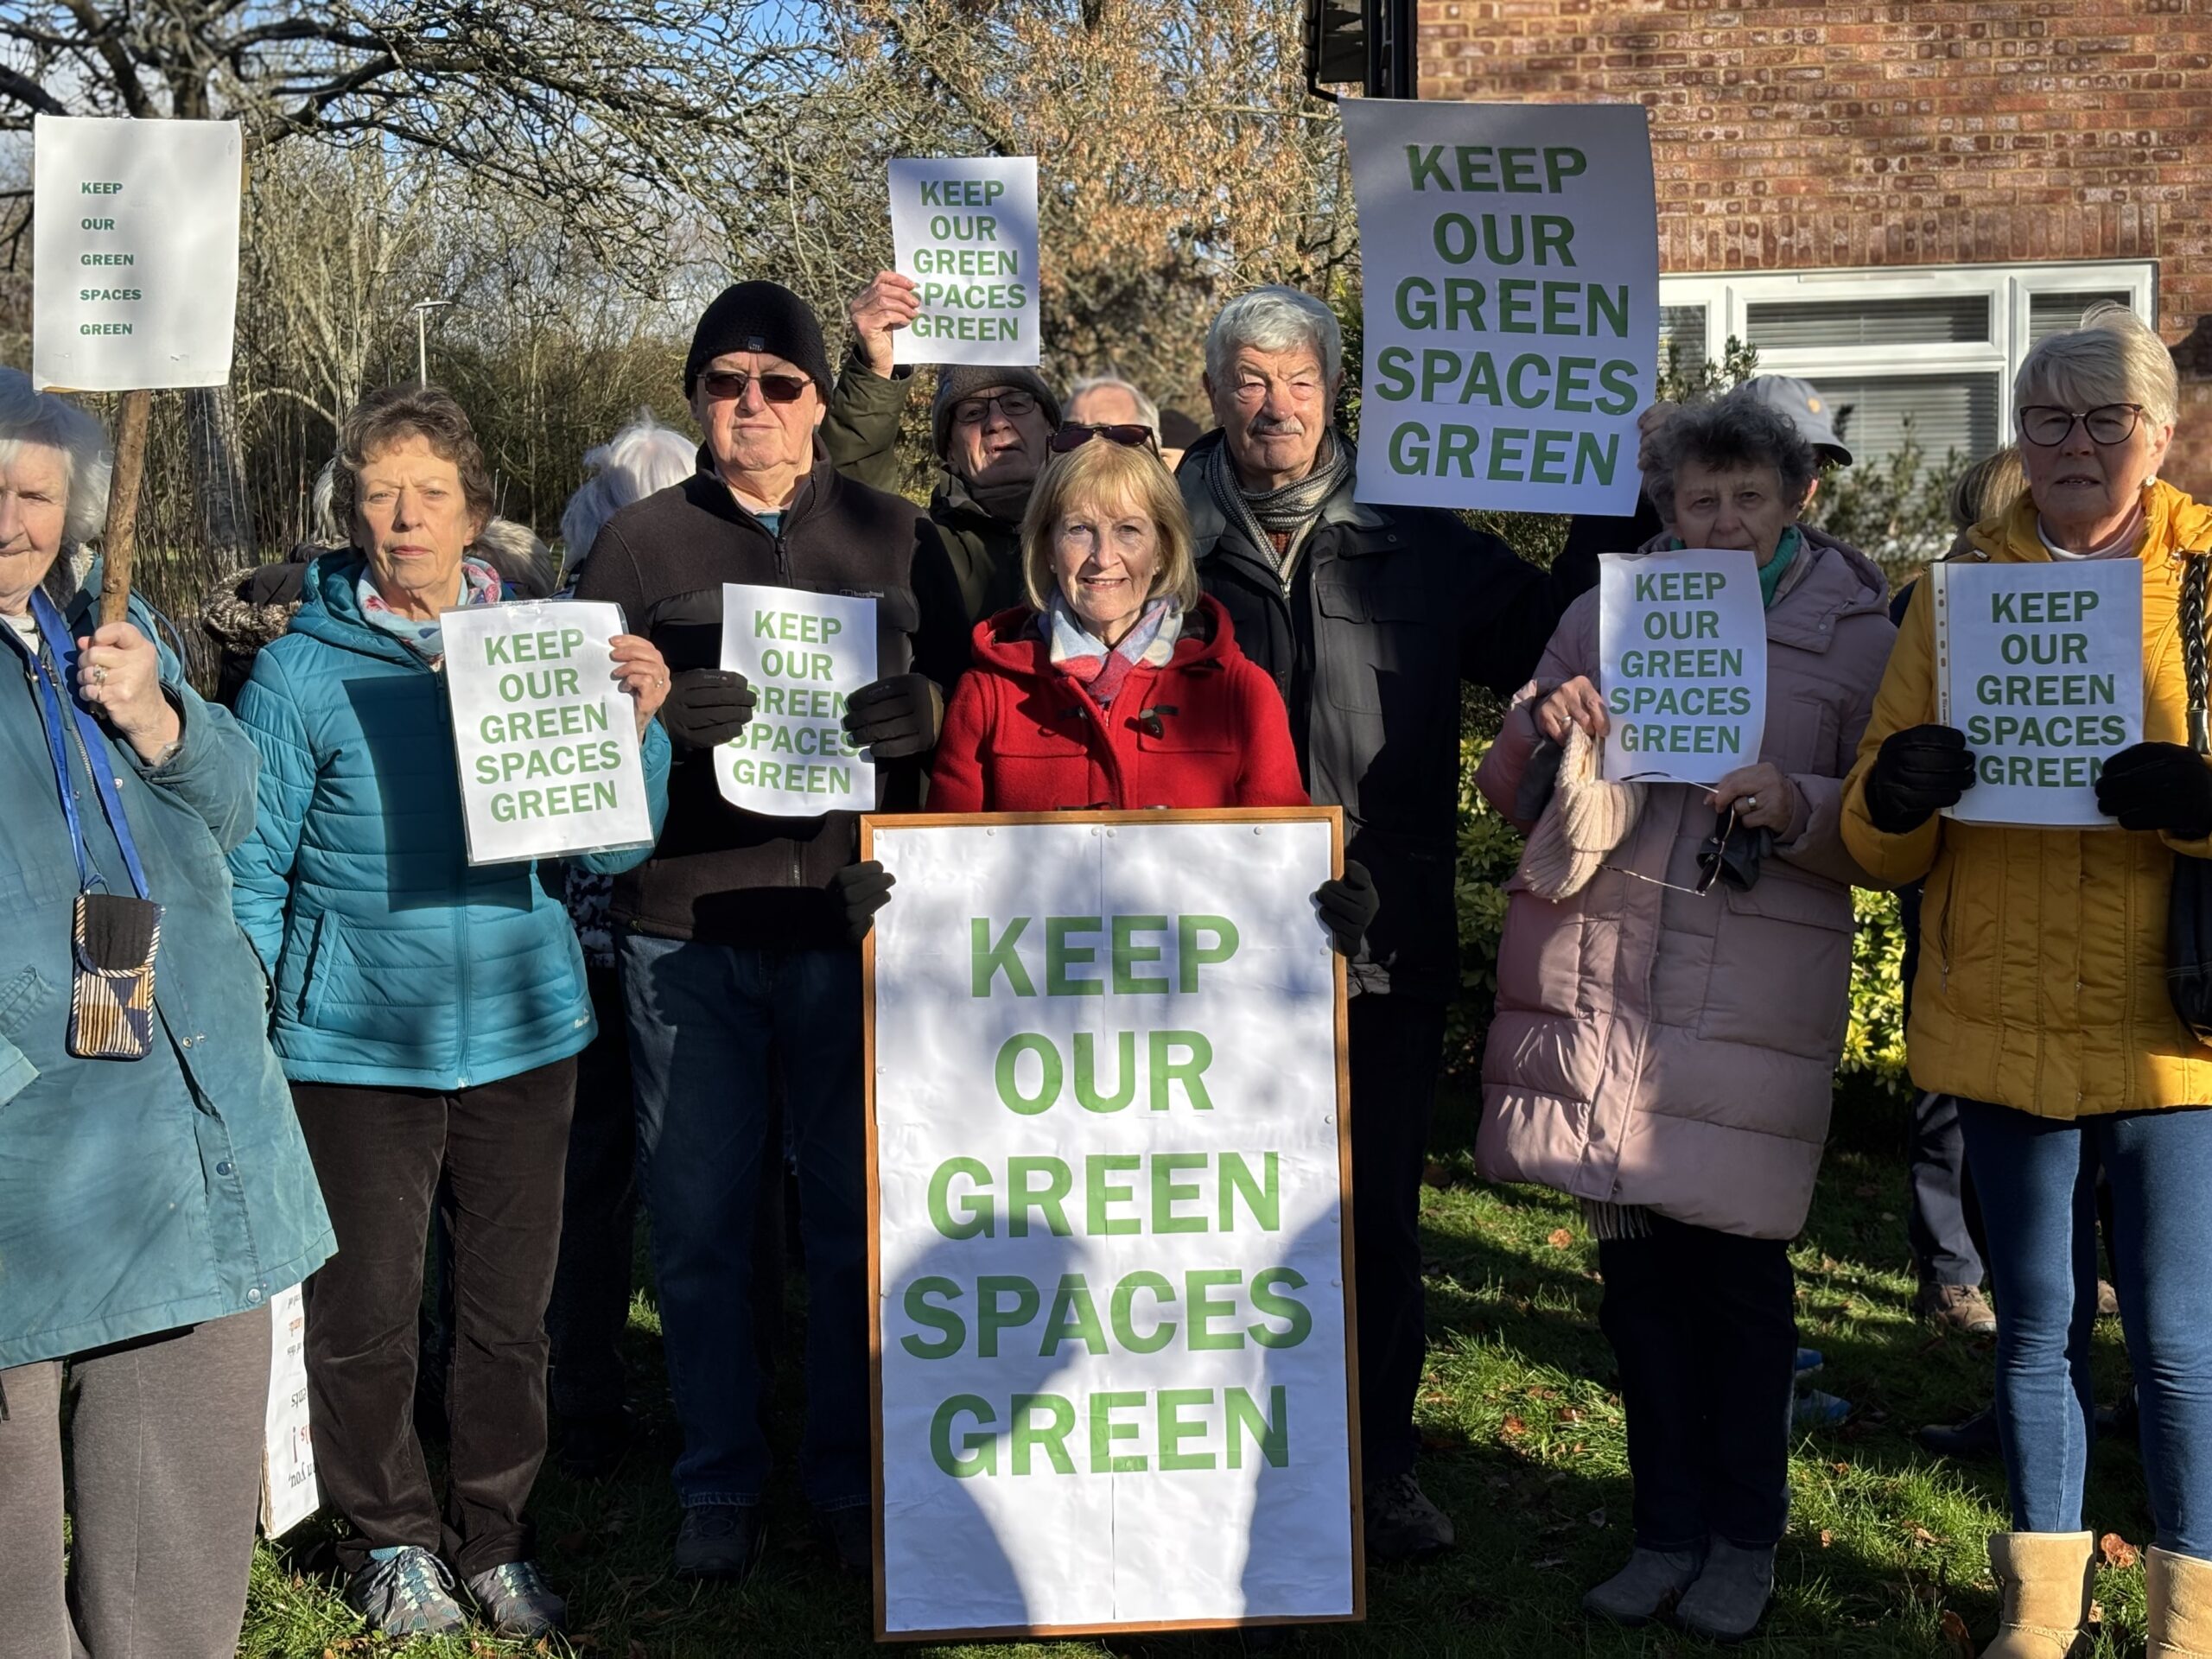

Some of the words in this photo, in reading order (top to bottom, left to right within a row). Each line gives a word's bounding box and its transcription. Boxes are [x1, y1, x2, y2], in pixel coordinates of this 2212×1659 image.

[1406, 144, 1587, 194] KEEP
[81, 182, 123, 194] KEEP
[919, 180, 1005, 207] KEEP
[81, 219, 115, 231] OUR
[930, 214, 997, 242] OUR
[1433, 212, 1578, 267] OUR
[80, 254, 134, 266] GREEN
[912, 248, 1019, 276] GREEN
[79, 289, 142, 301] SPACES
[1395, 276, 1629, 338] GREEN
[79, 323, 133, 335] GREEN
[911, 313, 1020, 342] GREEN
[1374, 346, 1639, 416] SPACES
[1388, 422, 1619, 486] GREEN
[1635, 571, 1727, 602] KEEP
[1990, 590, 2100, 624] KEEP
[754, 610, 842, 644] KEEP
[1643, 610, 1719, 640] OUR
[484, 628, 584, 666] KEEP
[1619, 648, 1743, 678] GREEN
[2000, 633, 2088, 665] OUR
[760, 649, 834, 681] OUR
[499, 668, 581, 702] OUR
[1608, 686, 1751, 716] SPACES
[1975, 674, 2115, 706] GREEN
[480, 702, 609, 744] GREEN
[1619, 723, 1741, 754] GREEN
[1967, 715, 2126, 747] SPACES
[475, 741, 622, 785] SPACES
[732, 759, 851, 794] GREEN
[490, 780, 618, 823] GREEN
[970, 915, 1241, 998] KEEP
[994, 1029, 1213, 1116] OUR
[926, 1151, 1281, 1239] GREEN
[899, 1267, 1312, 1360] SPACES
[929, 1385, 1289, 1478] GREEN
